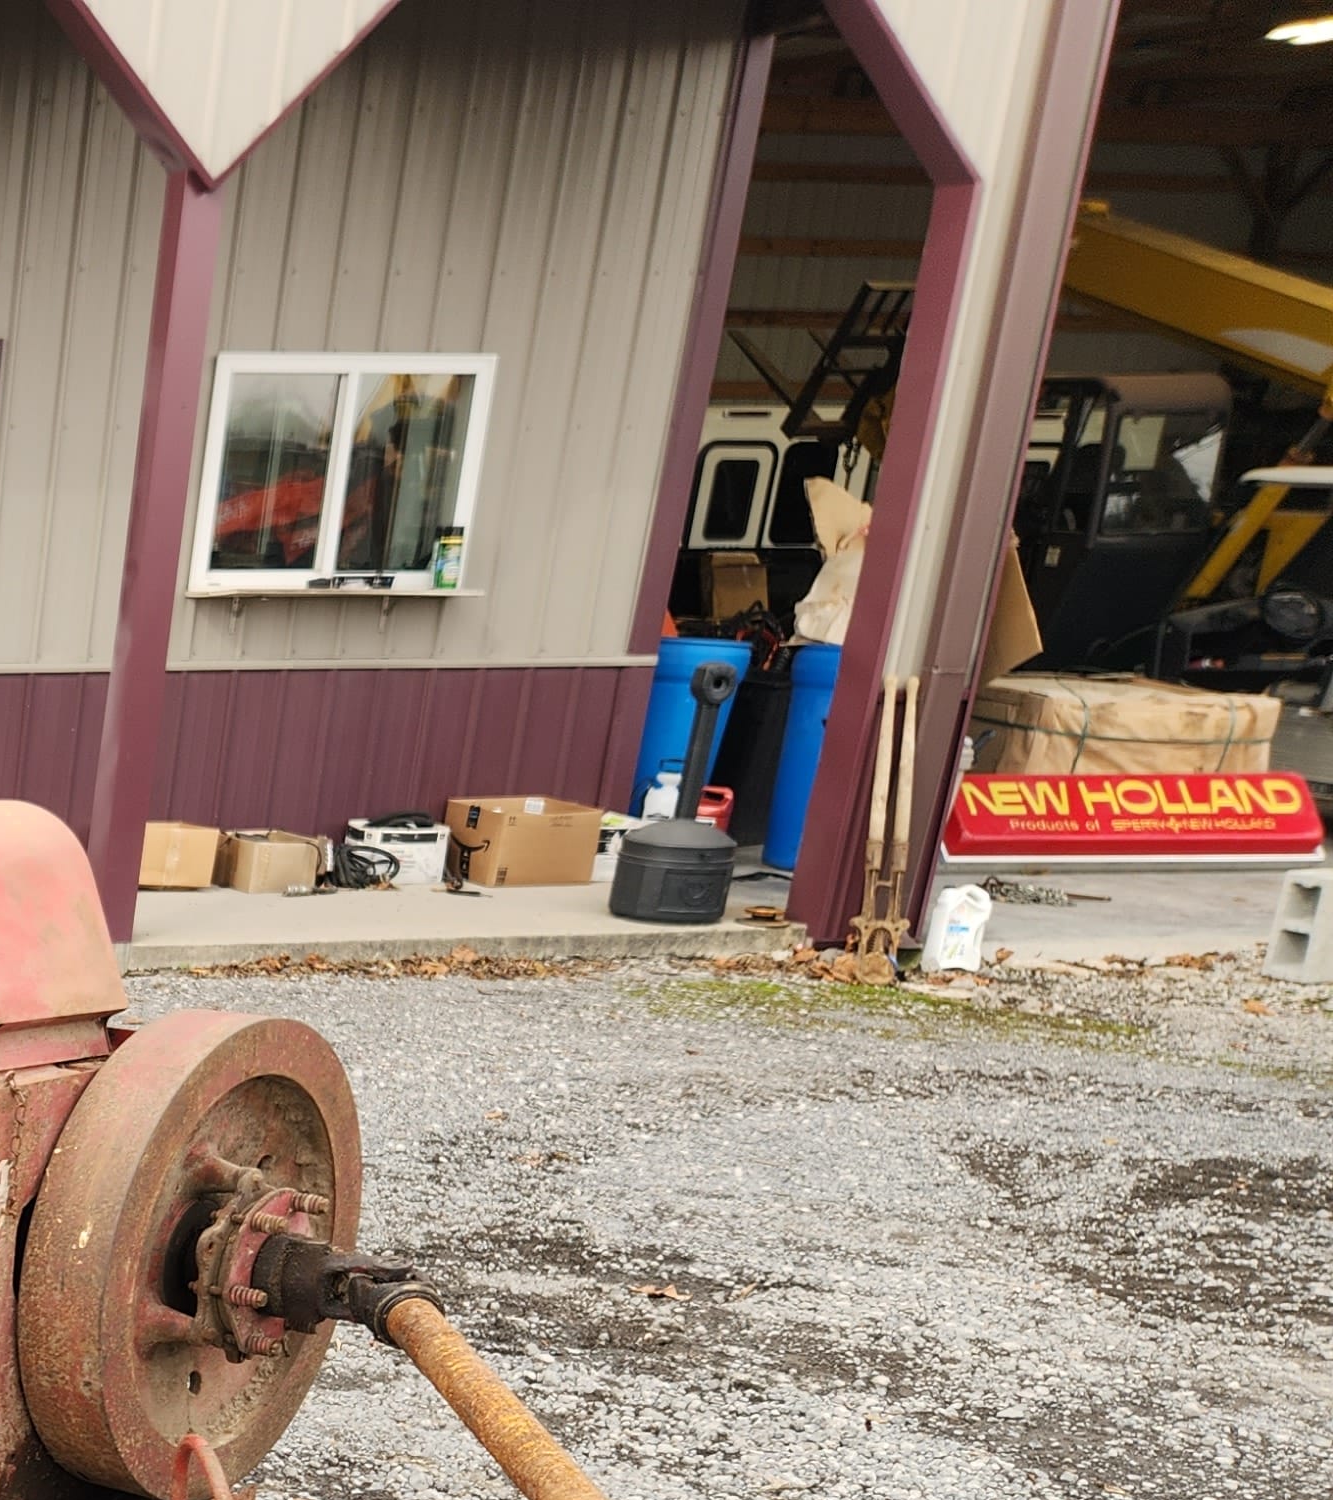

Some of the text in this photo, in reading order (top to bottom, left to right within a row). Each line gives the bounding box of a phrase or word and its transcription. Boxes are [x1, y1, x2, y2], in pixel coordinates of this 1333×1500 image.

[961, 779, 1303, 816] NEW HOLLAND
[1009, 818, 1080, 832] Products
[1085, 818, 1101, 832] of
